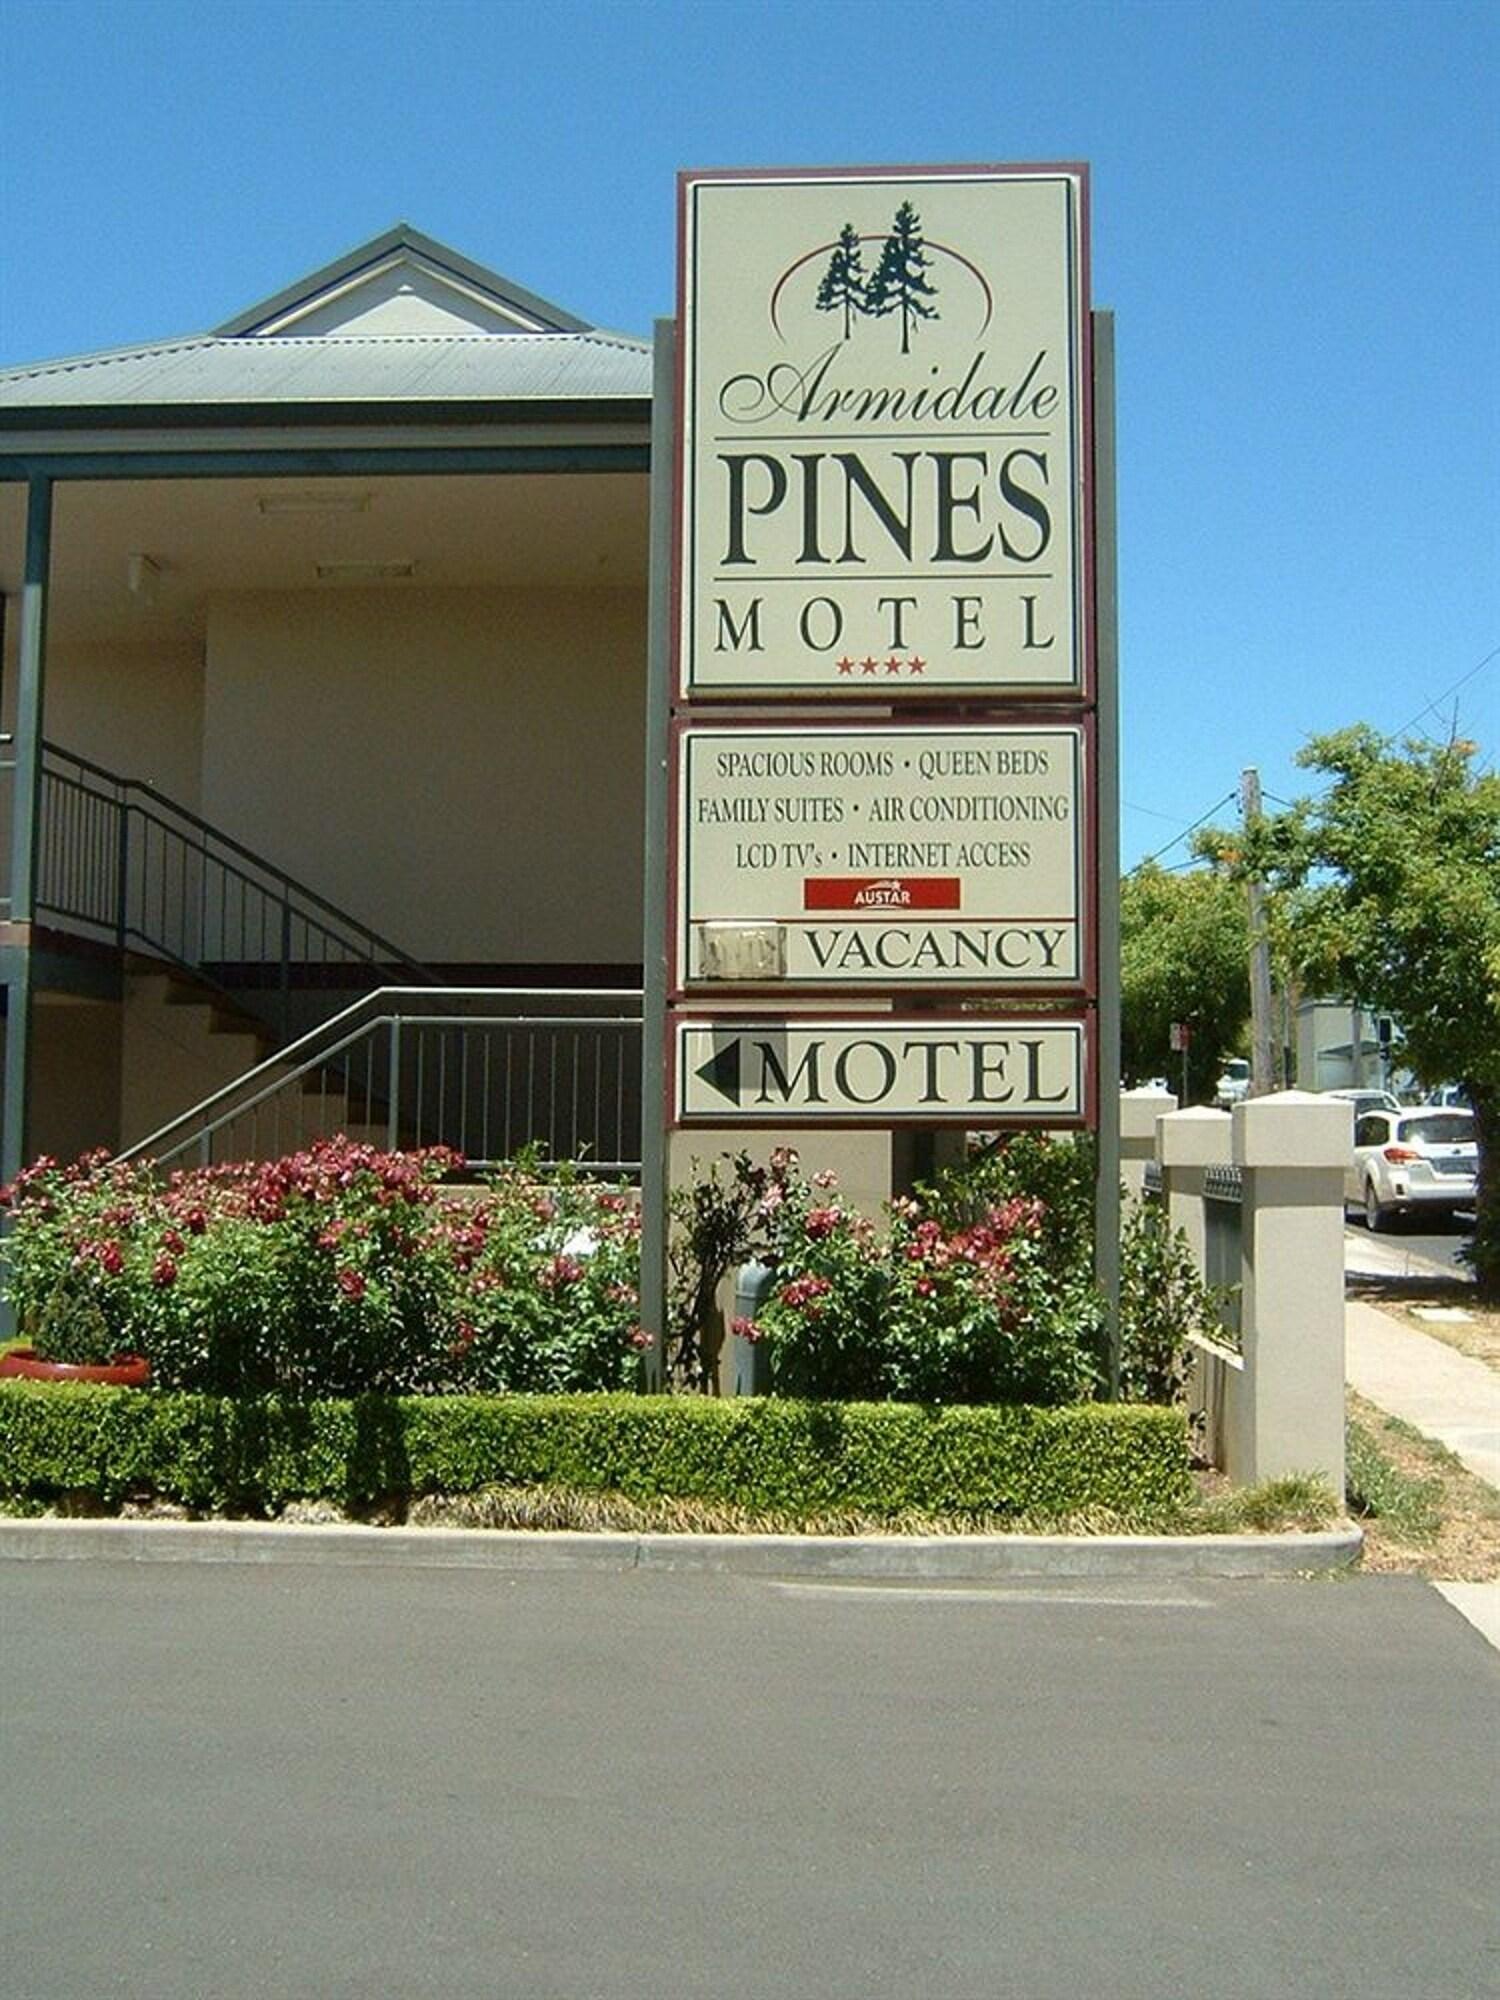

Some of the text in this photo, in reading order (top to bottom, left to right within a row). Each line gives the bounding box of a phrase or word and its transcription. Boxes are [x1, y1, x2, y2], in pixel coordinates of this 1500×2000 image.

[719, 342, 1060, 424] Armidale
[716, 448, 1052, 565] PINES
[713, 596, 1055, 652] MOTEL
[717, 749, 1049, 780] SPACIOUS ROOMS QUEEN BEDS
[698, 796, 1069, 823] FAMILY SUITES AIR CONDITIONING
[736, 841, 1031, 868] LCD TV's INTERNET ACCESS
[855, 890, 911, 905] AUSTAR
[804, 929, 1067, 969] VACANCY
[752, 1040, 1070, 1104] MOTEL
